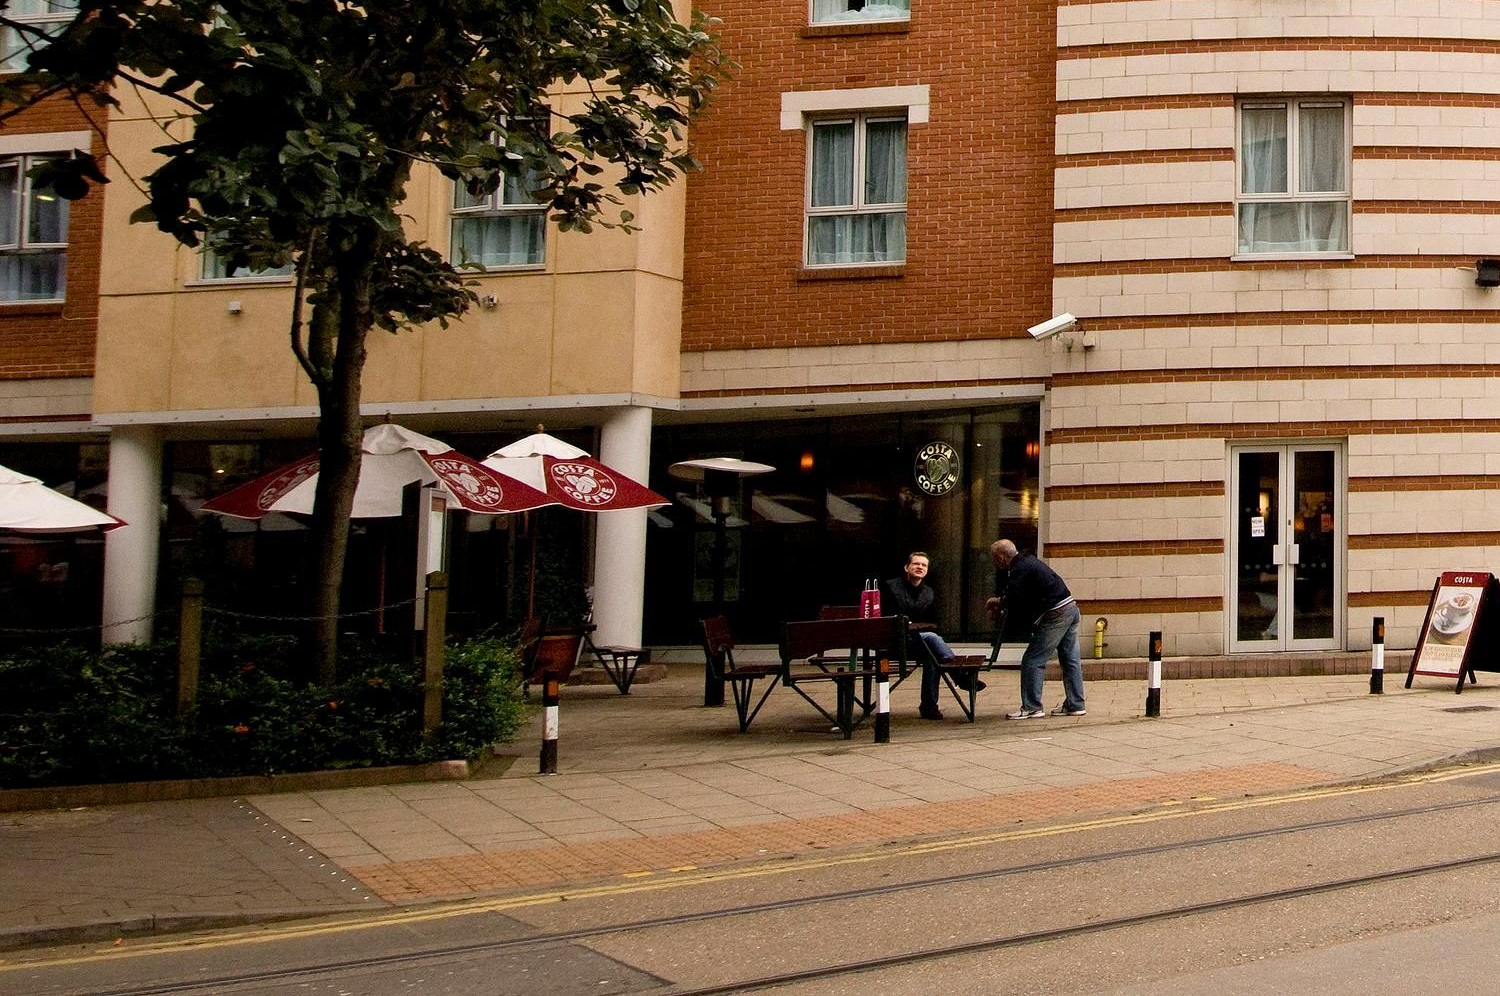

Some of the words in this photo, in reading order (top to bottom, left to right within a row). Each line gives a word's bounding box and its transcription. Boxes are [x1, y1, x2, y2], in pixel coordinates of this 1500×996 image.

[920, 443, 953, 461] COSTA
[553, 464, 595, 477] COSTA
[918, 473, 956, 493] COFFEE
[563, 485, 614, 503] COFFEE
[1454, 576, 1473, 584] COSTA
